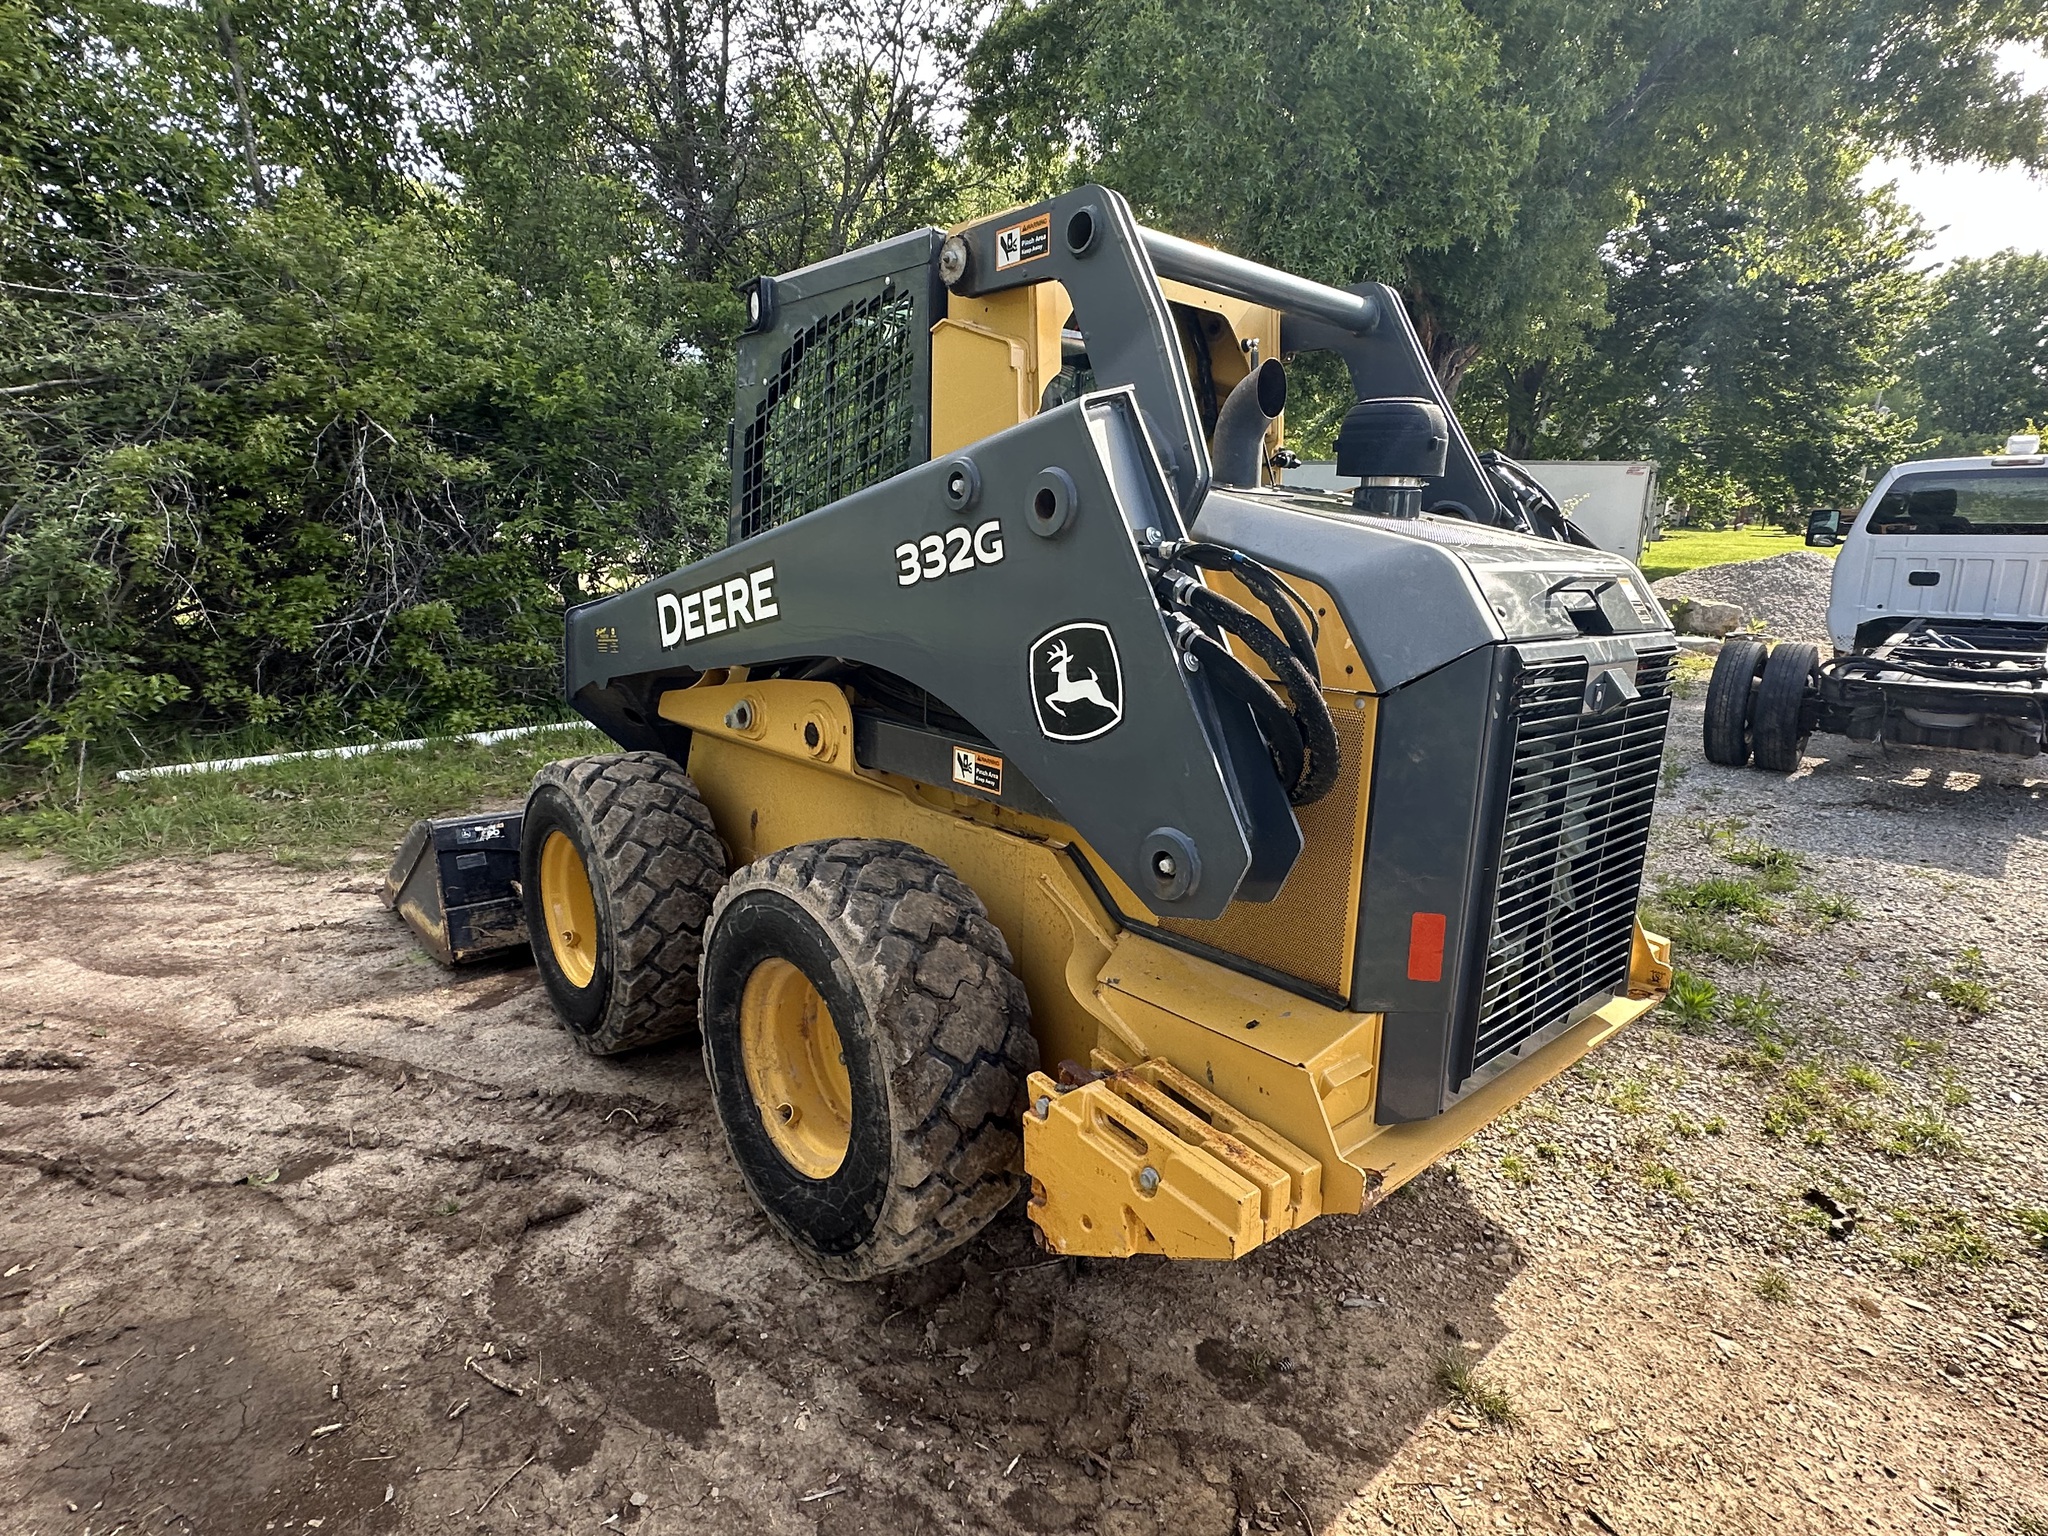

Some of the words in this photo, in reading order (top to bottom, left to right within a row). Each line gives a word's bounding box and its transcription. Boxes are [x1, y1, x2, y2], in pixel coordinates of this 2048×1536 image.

[1021, 237, 1035, 247] Pinch
[1035, 234, 1047, 243] Area
[895, 520, 1004, 587] 332G
[656, 565, 780, 649] DEERE
